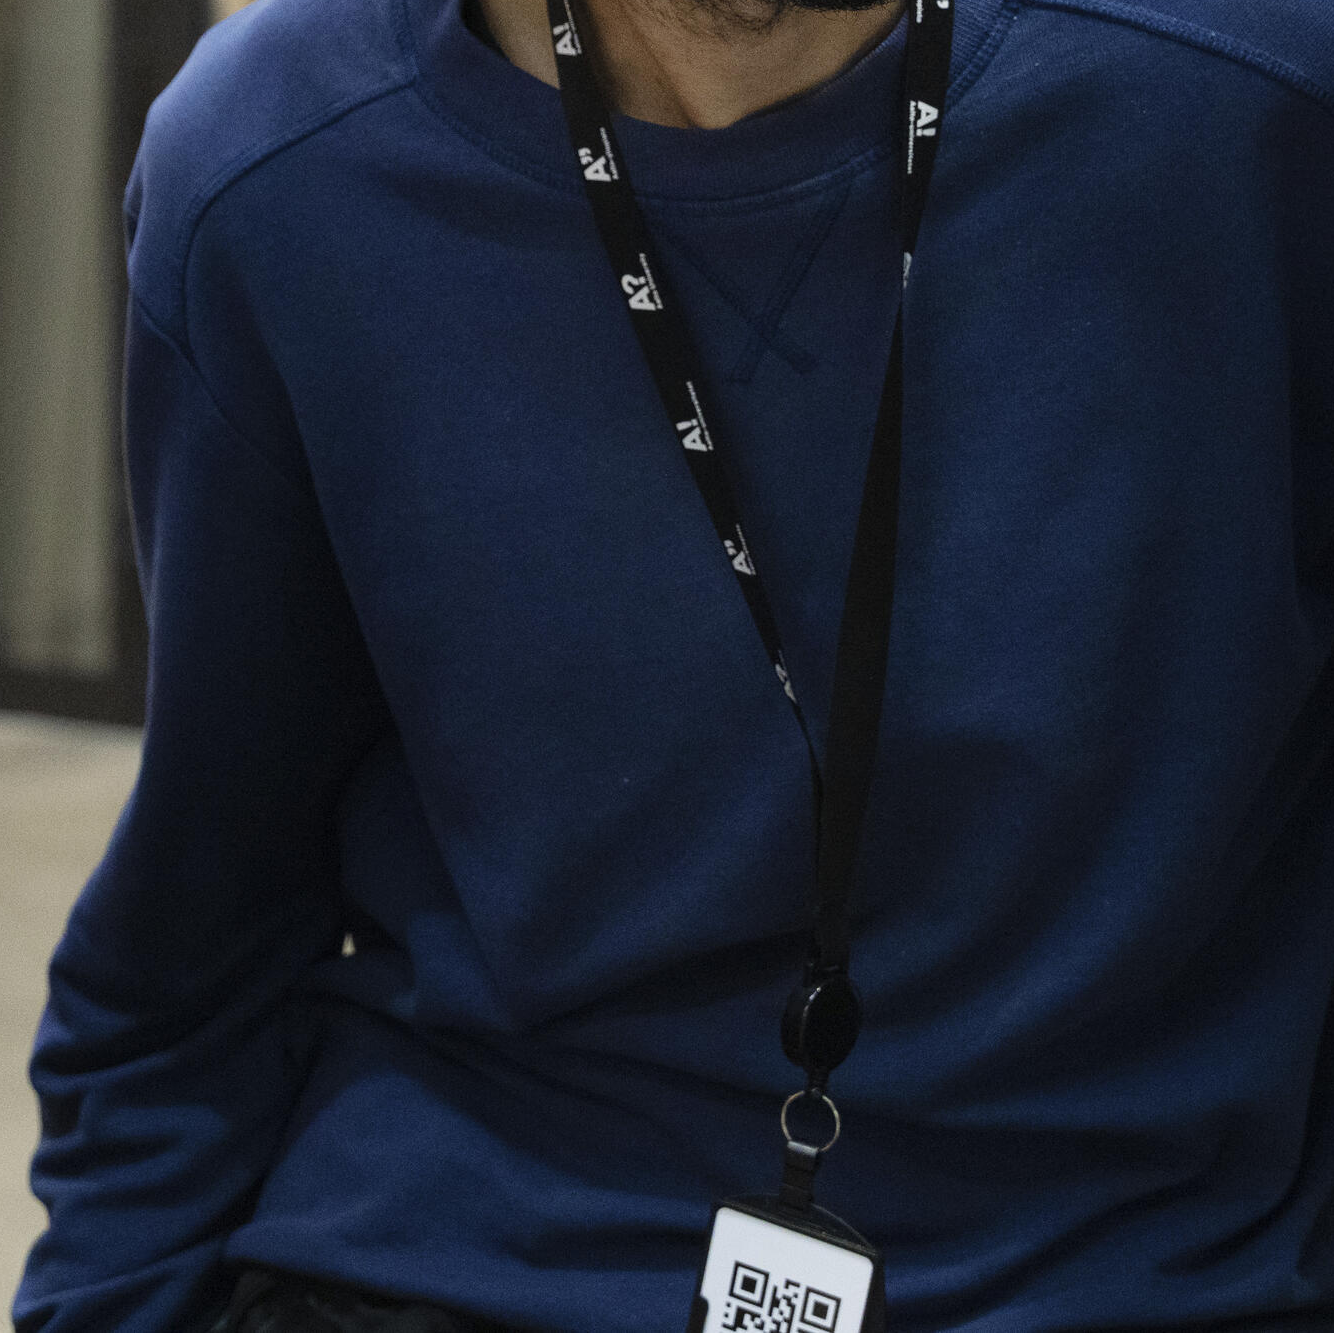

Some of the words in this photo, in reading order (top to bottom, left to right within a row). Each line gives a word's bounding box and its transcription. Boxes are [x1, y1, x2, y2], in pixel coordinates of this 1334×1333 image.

[553, 23, 577, 56] A!
[916, 100, 939, 137] A!
[621, 274, 656, 311] A?
[676, 418, 708, 452] A!
